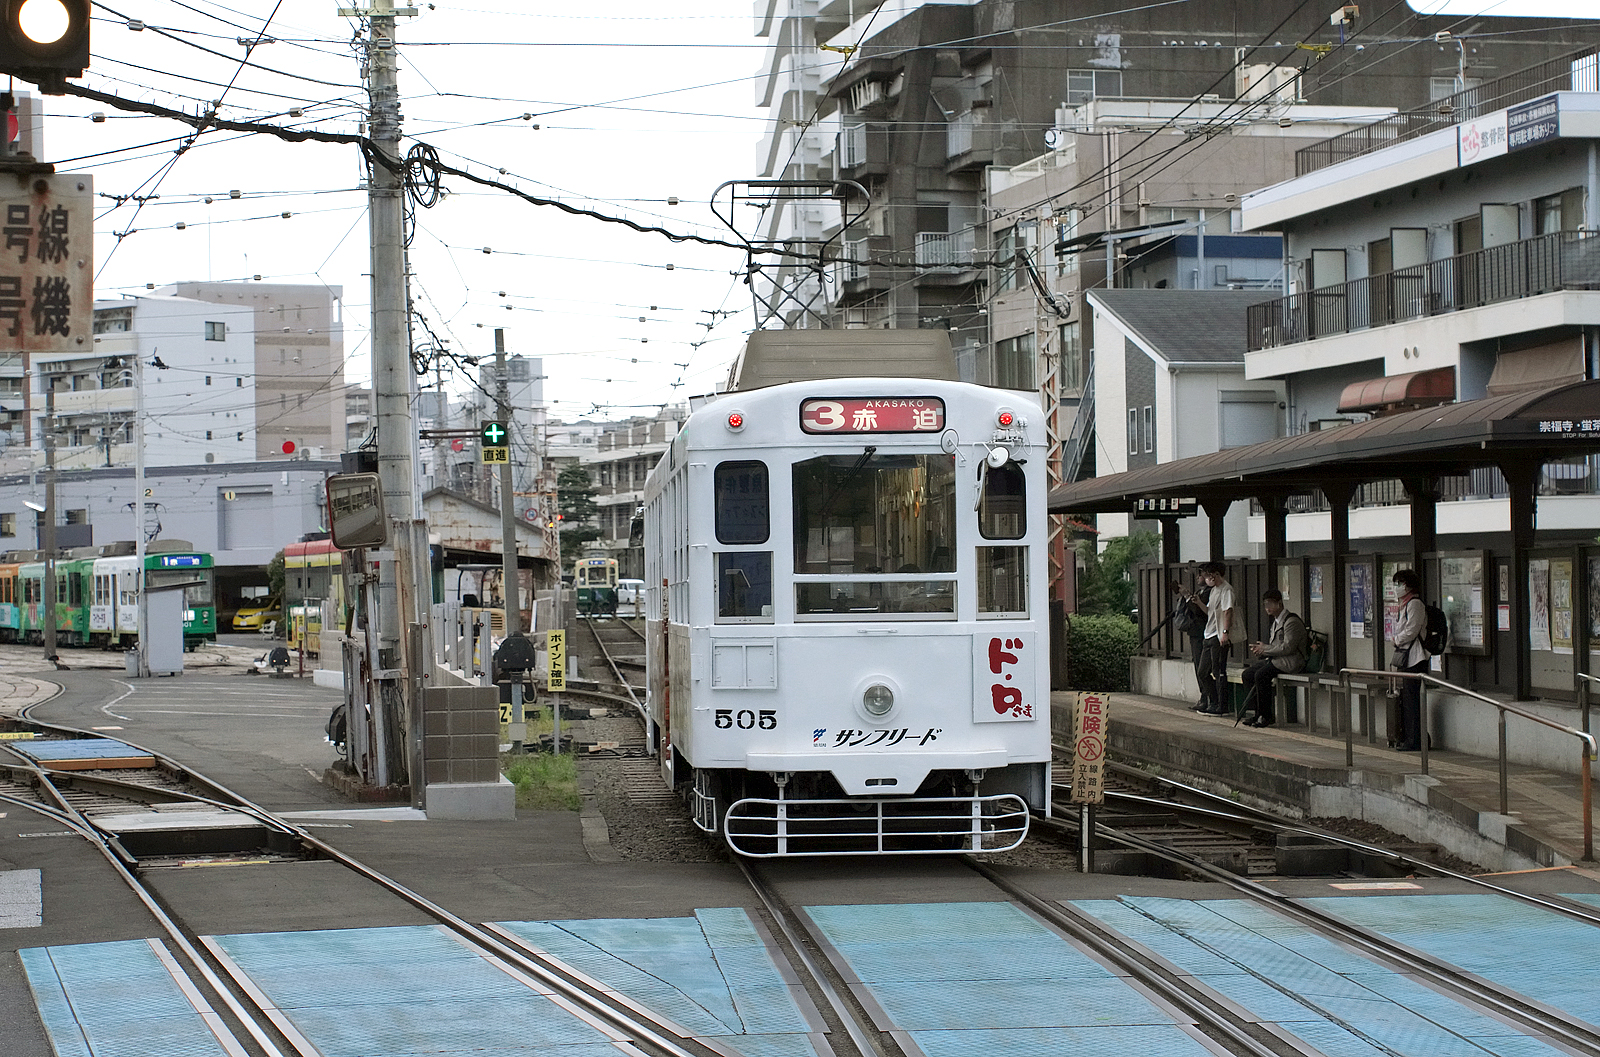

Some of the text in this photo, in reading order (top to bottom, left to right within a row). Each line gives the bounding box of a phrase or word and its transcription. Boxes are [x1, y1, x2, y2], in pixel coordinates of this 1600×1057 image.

[1480, 126, 1506, 149] 整骨院
[1509, 122, 1550, 147] 専用駐車場あり
[3, 204, 70, 264] 号線
[0, 276, 71, 337] 号機
[803, 401, 846, 431] 3
[483, 449, 507, 461] 直進
[144, 488, 152, 496] 2
[550, 634, 563, 687] ポイント確認
[714, 709, 777, 729] 505
[1082, 696, 1103, 735] 危険
[832, 728, 943, 748] サンフリード
[1077, 764, 1088, 798] 立入禁止
[1088, 764, 1099, 798] 線路内
